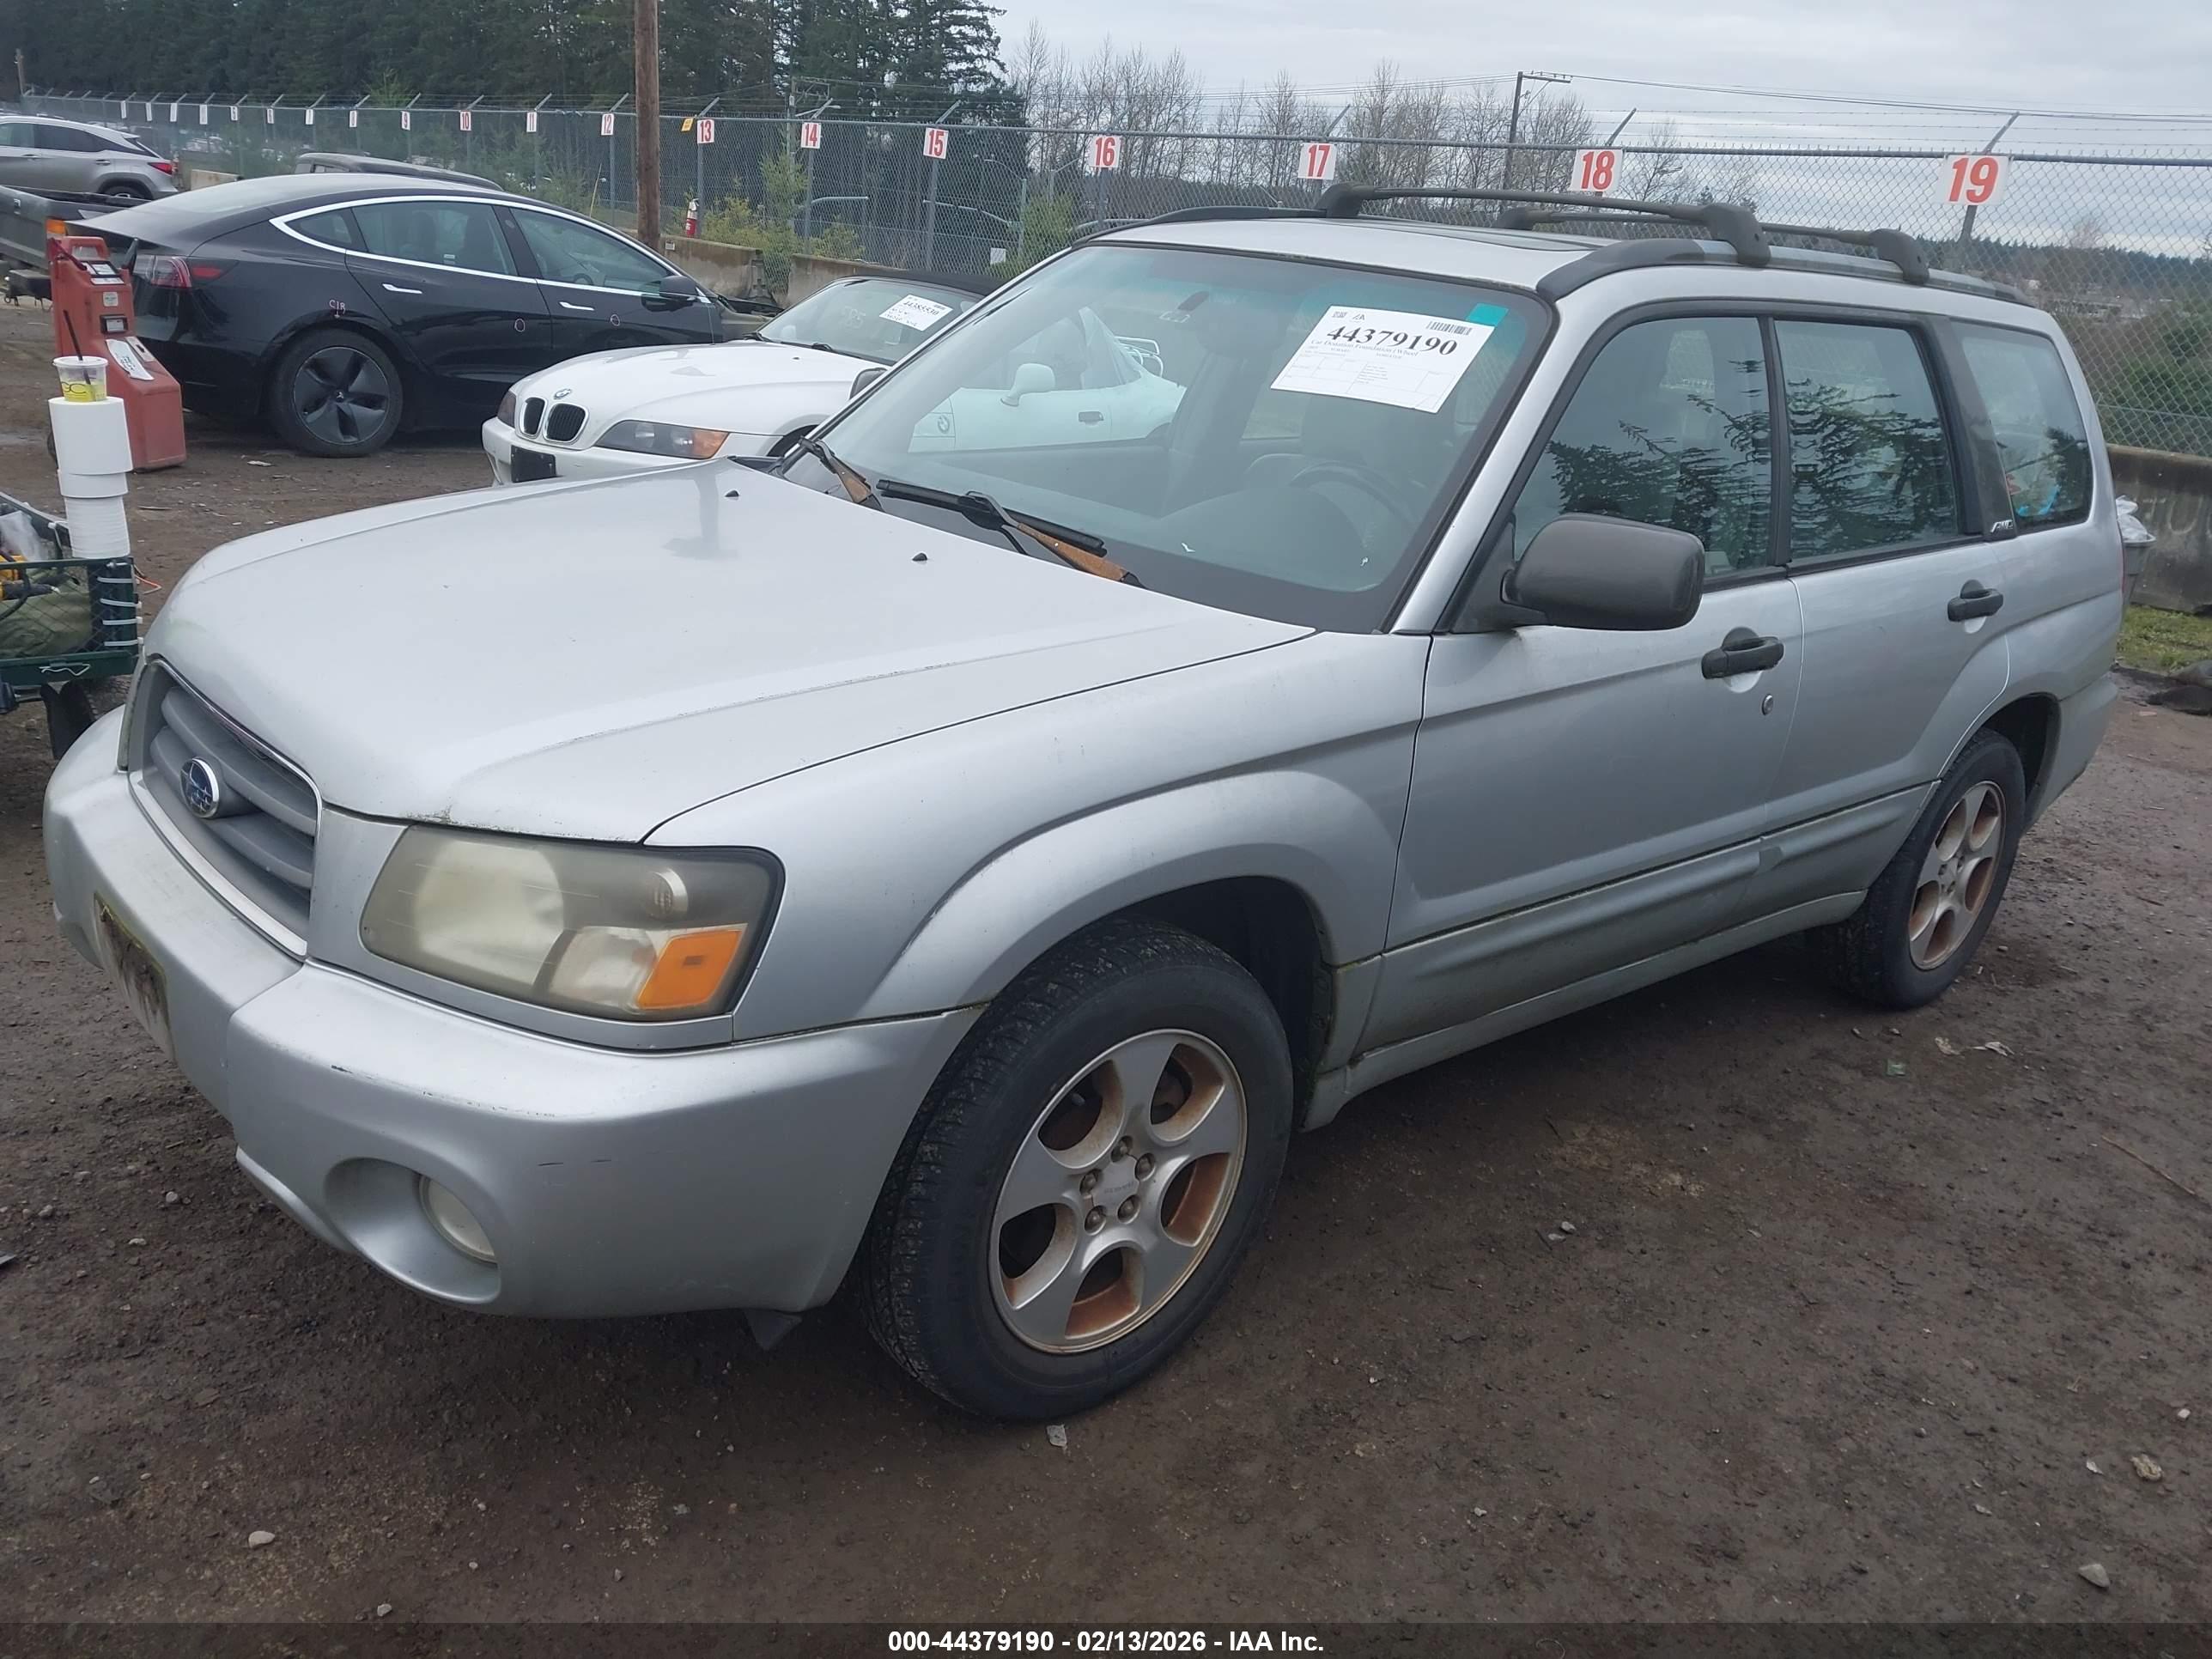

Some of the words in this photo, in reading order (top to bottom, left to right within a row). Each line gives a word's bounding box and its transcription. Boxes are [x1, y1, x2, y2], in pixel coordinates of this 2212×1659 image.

[461, 112, 470, 129] 10
[529, 113, 536, 131] 11
[604, 113, 612, 134] 12
[700, 119, 712, 143] 13
[805, 123, 817, 147] 14
[927, 130, 944, 157] 15
[1095, 137, 1115, 167] 16
[1306, 144, 1331, 178] 17
[1580, 149, 1616, 190] 18
[1948, 156, 1999, 204] 19
[1327, 325, 1458, 356] 44379190
